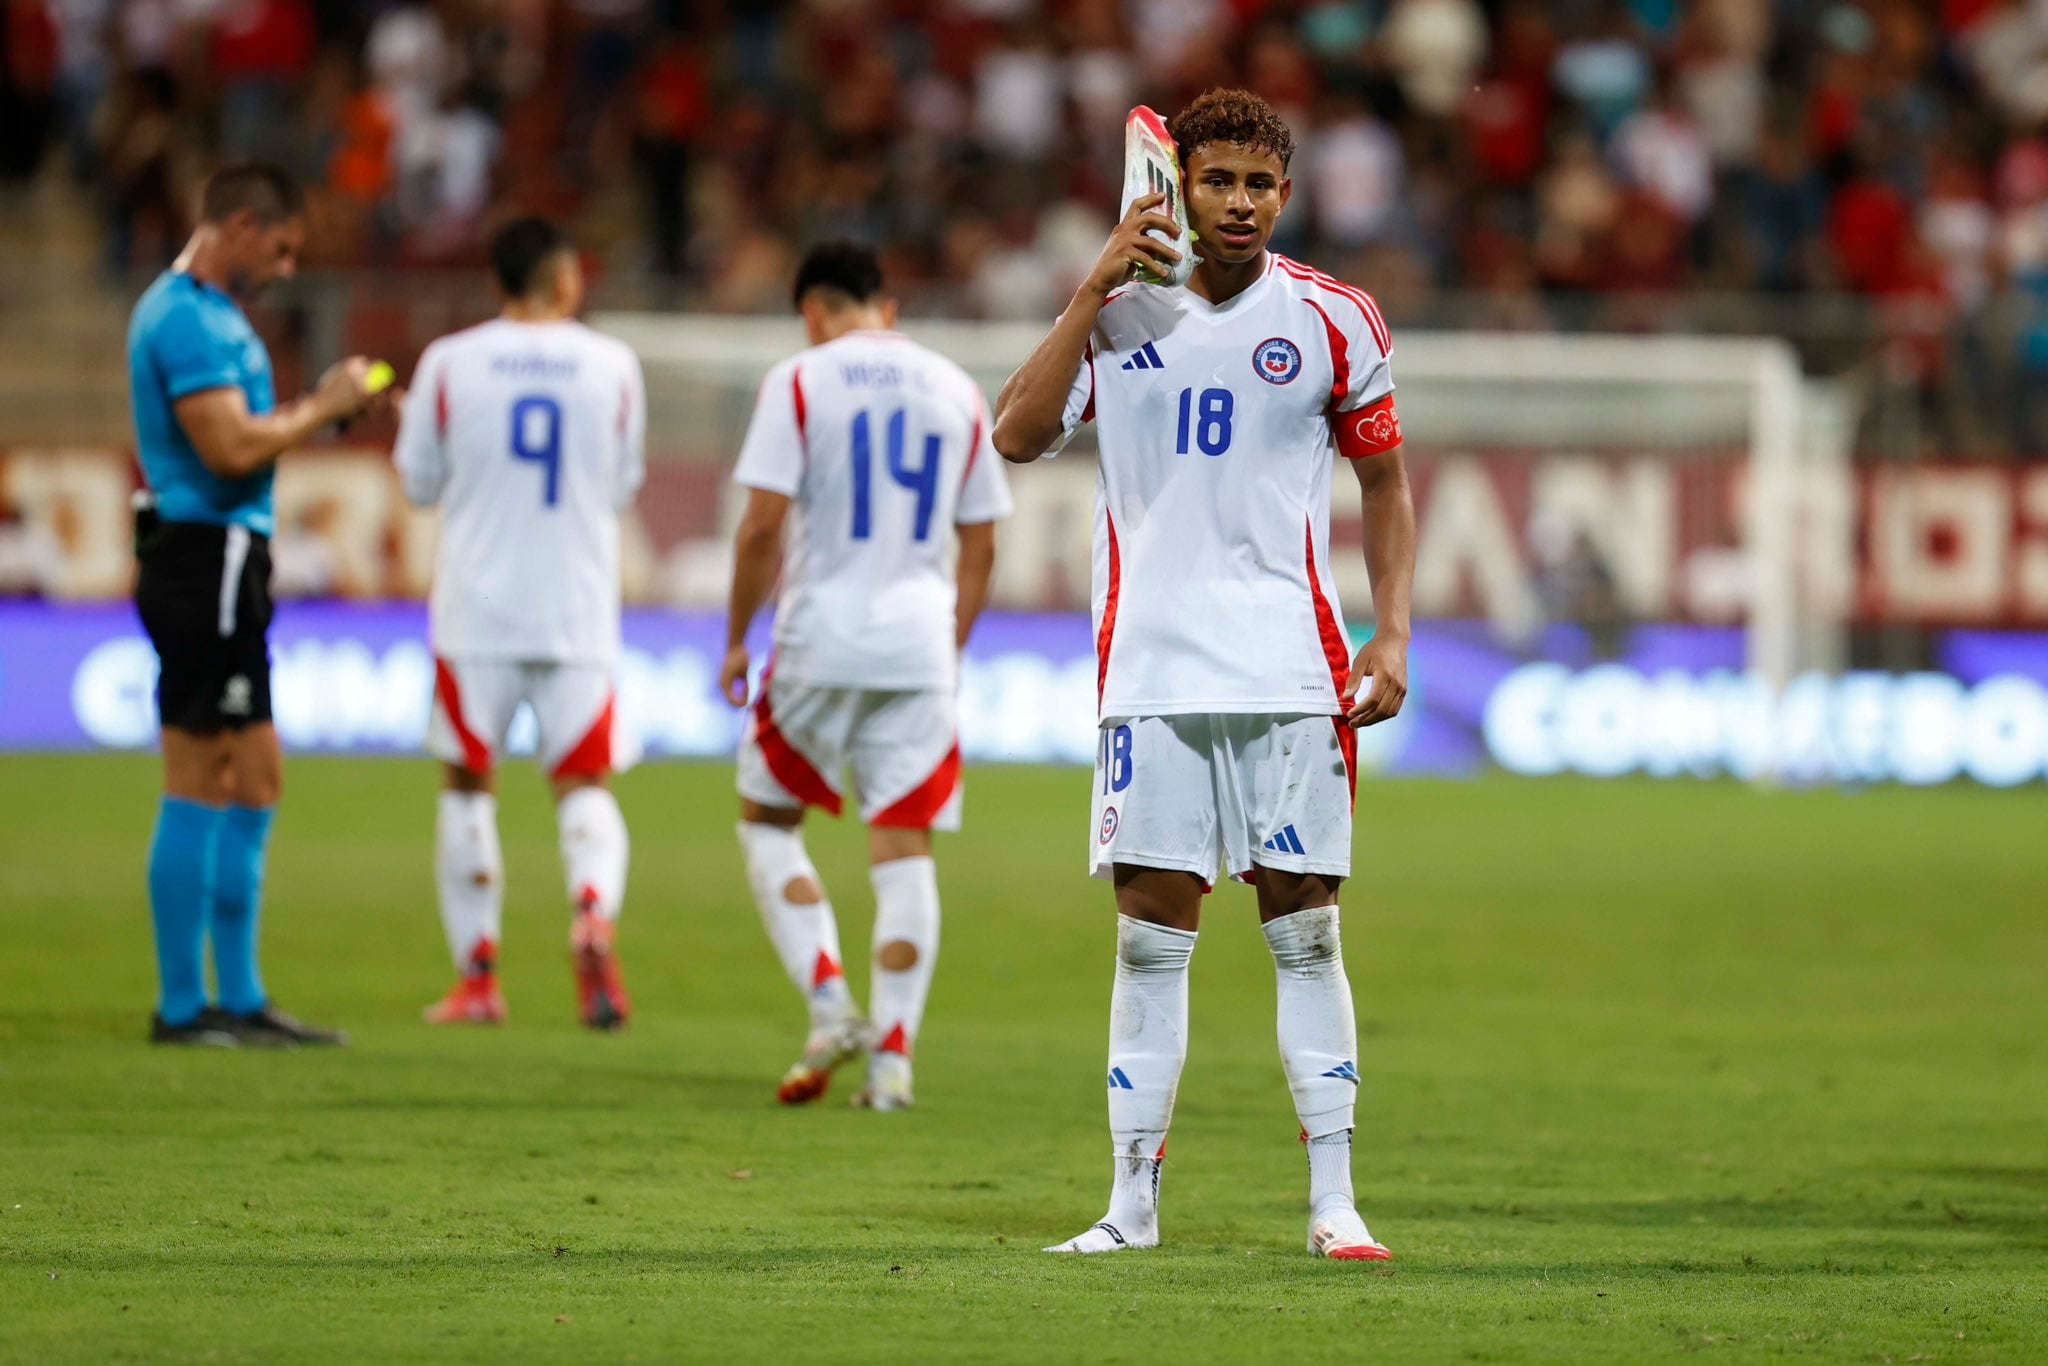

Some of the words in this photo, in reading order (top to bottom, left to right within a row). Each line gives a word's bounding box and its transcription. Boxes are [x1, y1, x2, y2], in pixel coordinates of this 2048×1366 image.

[511, 395, 562, 507] 9
[1176, 387, 1234, 456] 18
[851, 407, 942, 541] 14
[1104, 725, 1132, 796] 18
